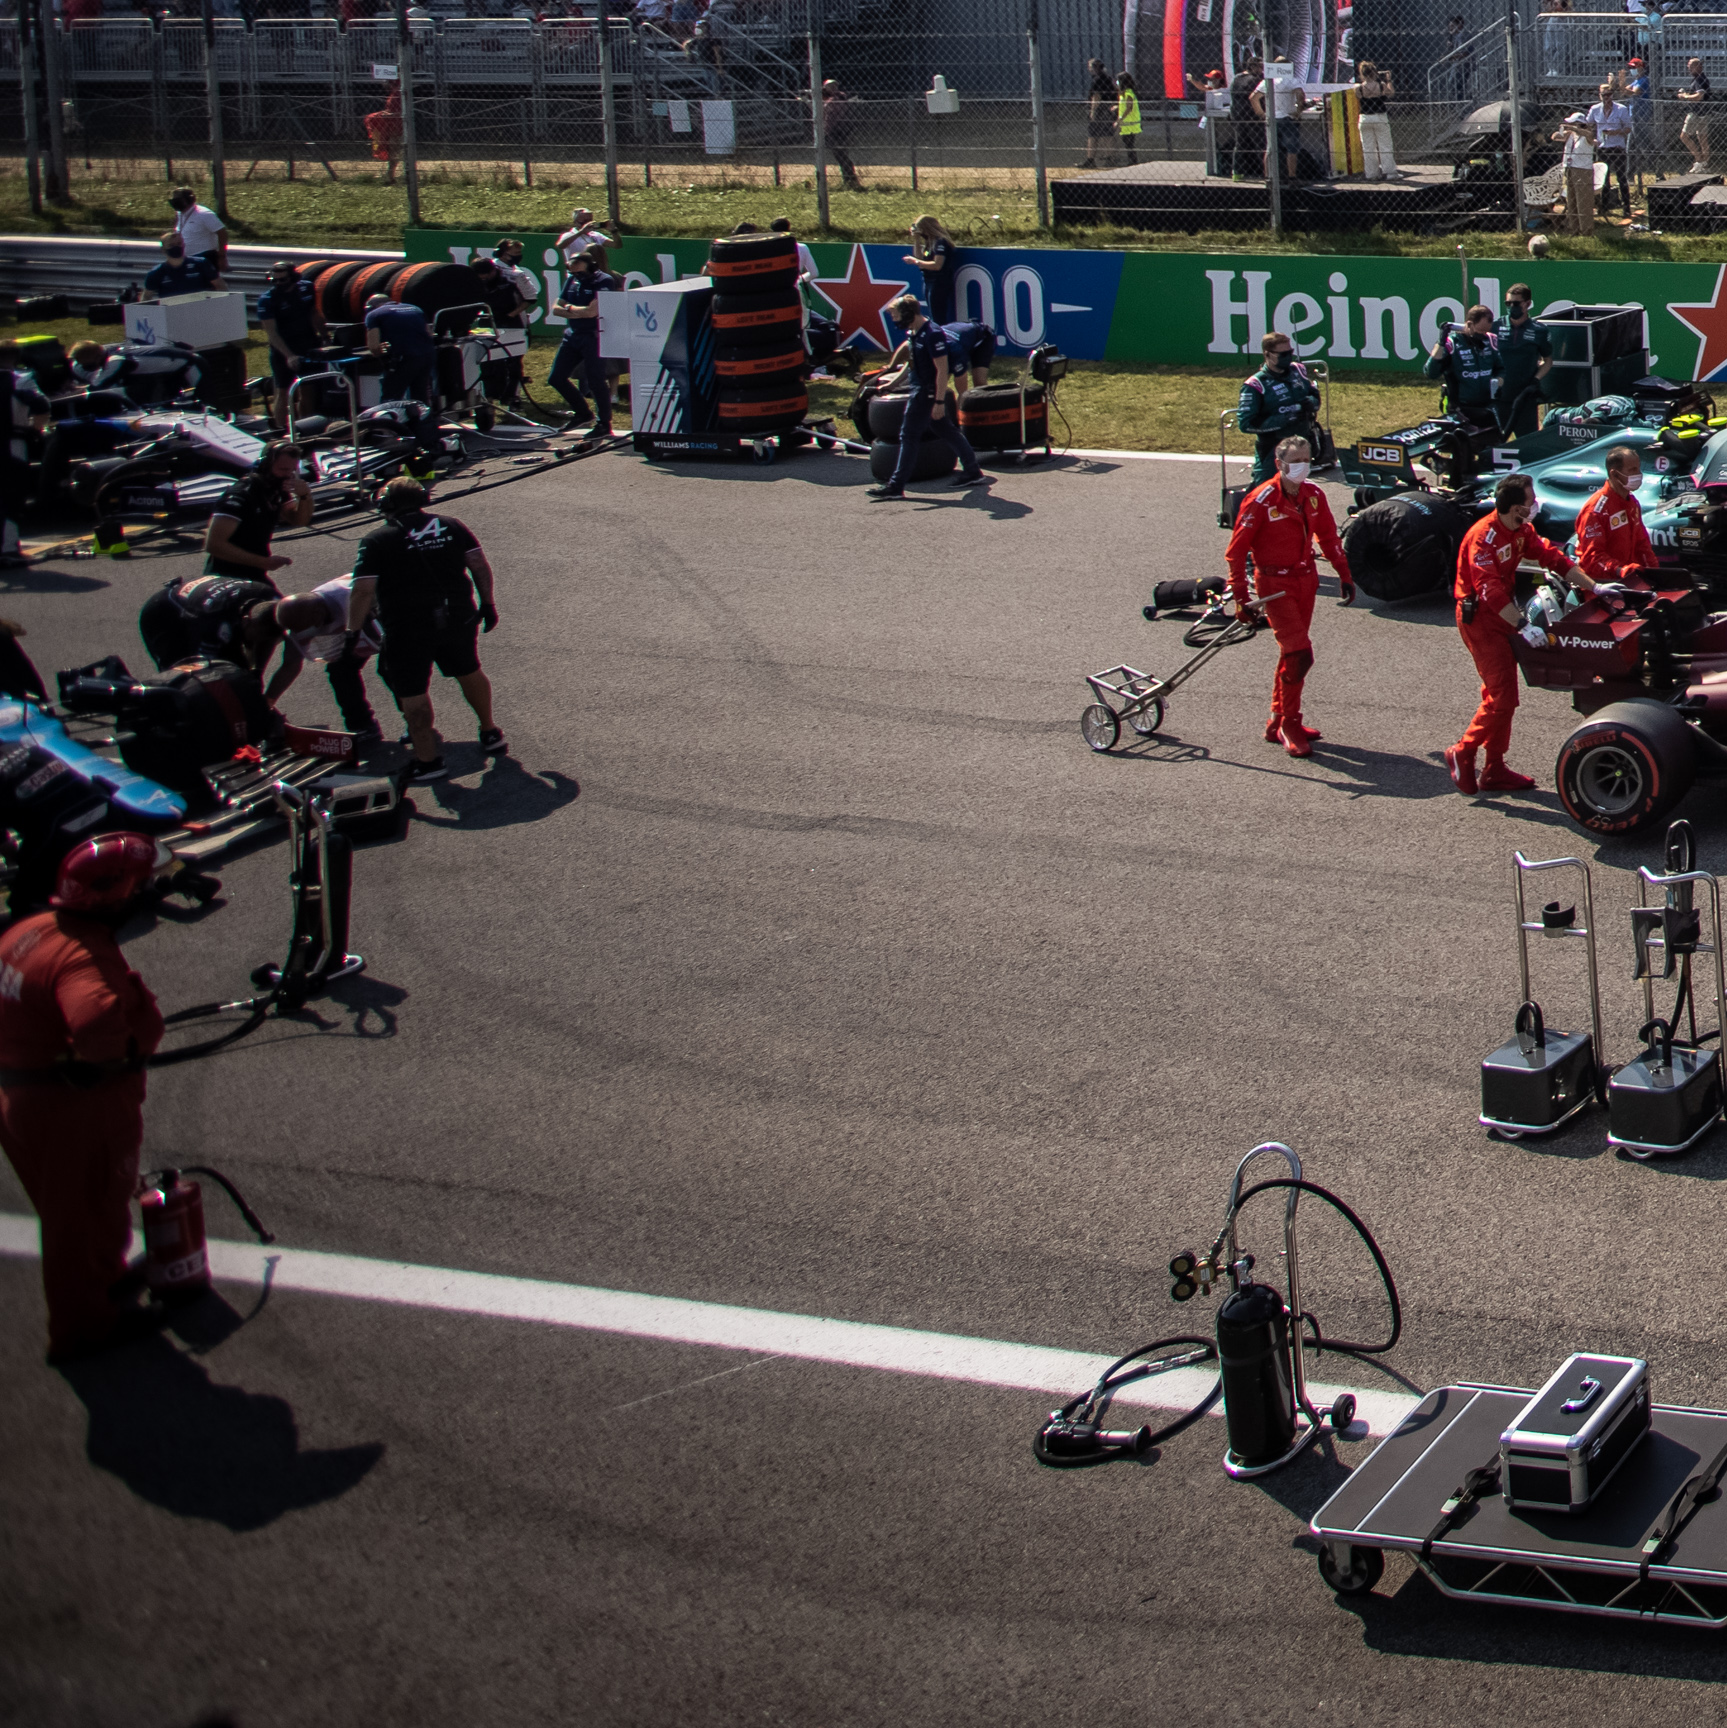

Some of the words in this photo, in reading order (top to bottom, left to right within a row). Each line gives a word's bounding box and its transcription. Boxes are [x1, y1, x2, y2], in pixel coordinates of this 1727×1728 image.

[1558, 424, 1598, 440] PERONI
[652, 442, 690, 450] WILLIAMS
[690, 442, 718, 451] RACING
[1362, 446, 1400, 462] JCB
[1492, 448, 1521, 473] 5
[1682, 528, 1699, 537] JCB
[1682, 540, 1700, 548] EPOS
[1558, 635, 1615, 650] V-Power
[318, 738, 340, 747] PLUG
[310, 745, 342, 755] POWER
